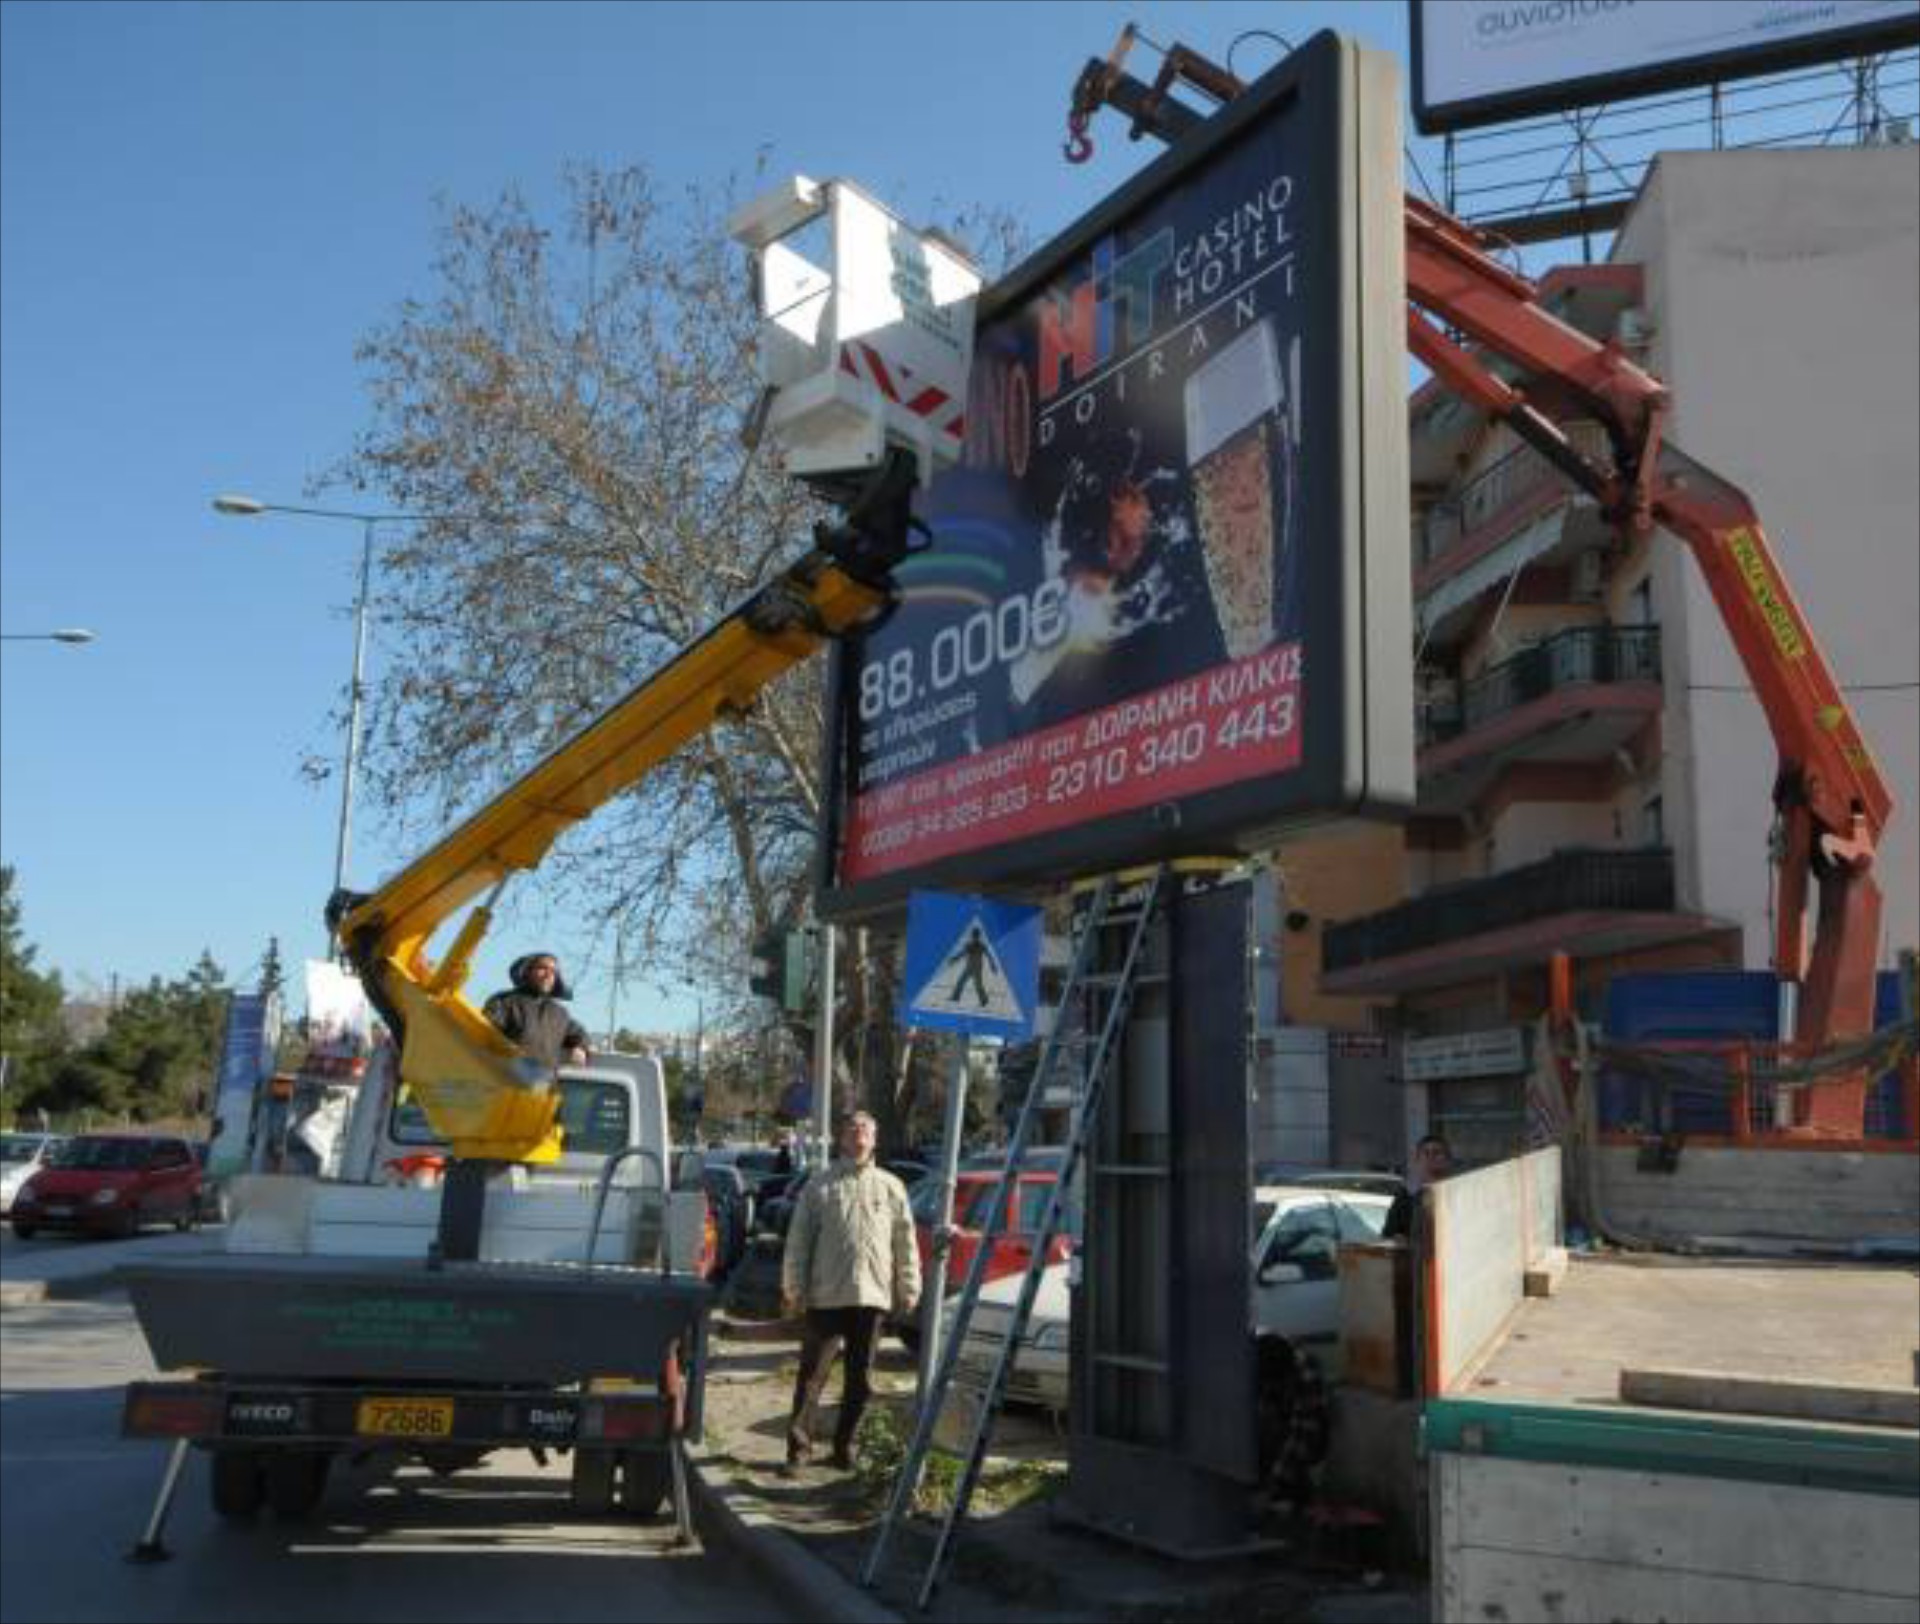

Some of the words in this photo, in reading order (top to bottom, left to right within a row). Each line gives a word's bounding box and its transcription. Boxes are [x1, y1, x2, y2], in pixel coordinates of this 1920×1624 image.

[1173, 213, 1291, 316] HOTEL
[1176, 175, 1292, 279] CASINO
[1037, 227, 1175, 400] HIT
[1038, 264, 1294, 447] DOIRANI
[859, 578, 1067, 721] 88.000€
[1083, 683, 1198, 750] ΔΟΙΡΑΝΗ
[1207, 643, 1302, 706] ΚΙΛΚΙΣ
[1047, 747, 1129, 803] 2310
[1136, 722, 1206, 776] 340
[1217, 693, 1295, 750] 443
